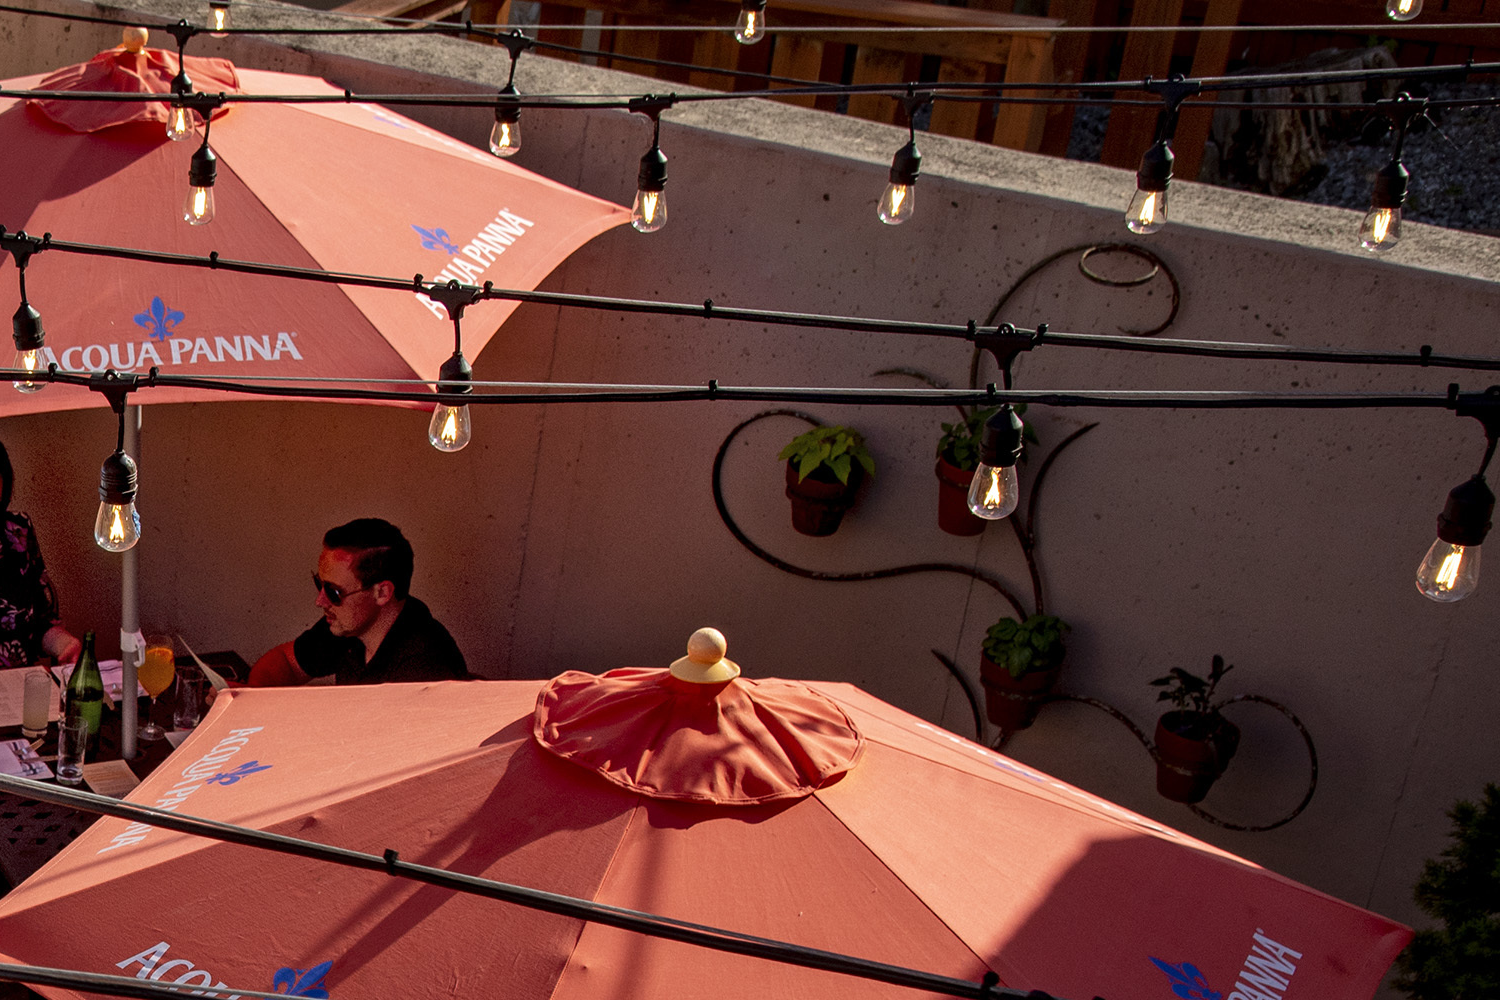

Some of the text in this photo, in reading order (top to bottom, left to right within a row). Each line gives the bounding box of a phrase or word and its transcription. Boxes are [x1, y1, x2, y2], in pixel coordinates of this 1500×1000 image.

[415, 257, 484, 320] AUA
[39, 340, 164, 372] ACQUA
[173, 726, 264, 788] ACQUA
